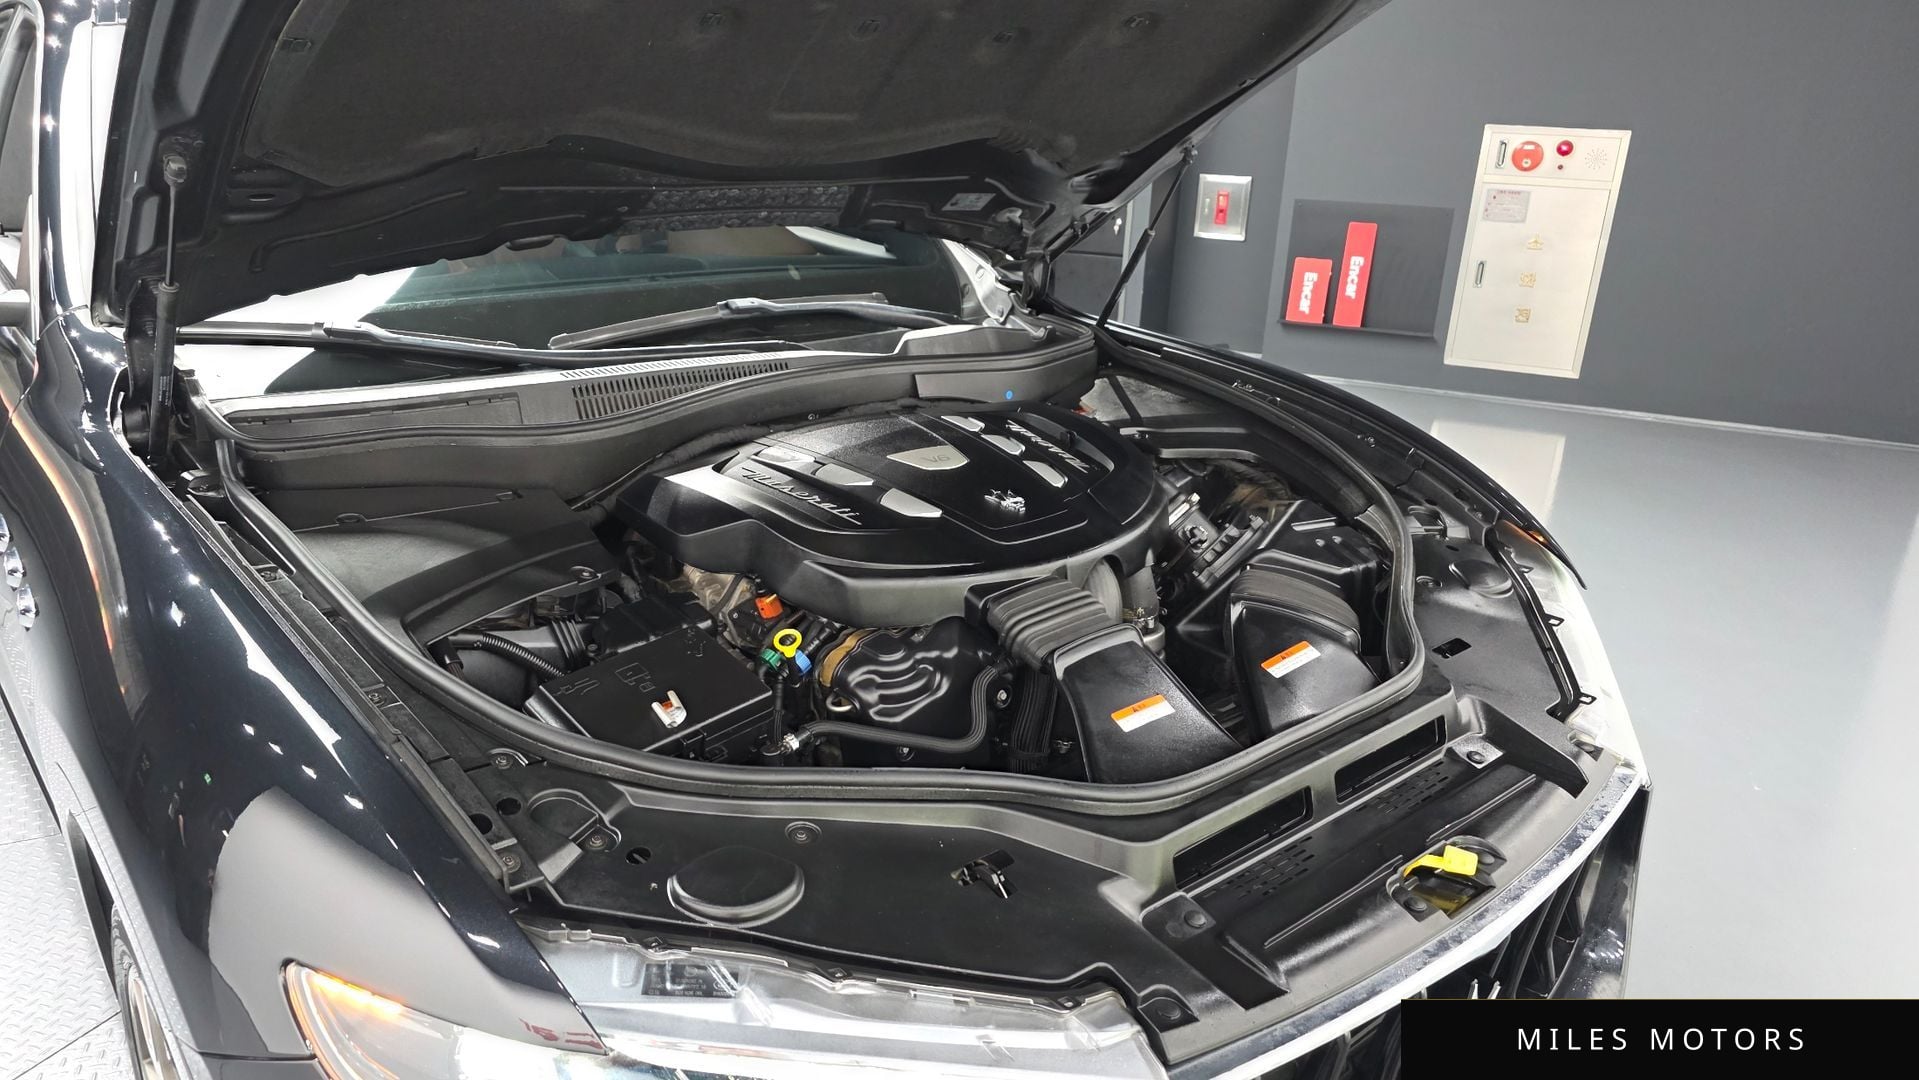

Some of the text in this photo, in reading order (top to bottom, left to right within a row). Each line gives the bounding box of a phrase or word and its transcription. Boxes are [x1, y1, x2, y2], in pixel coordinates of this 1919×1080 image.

[1299, 271, 1318, 315] Encar
[1345, 255, 1364, 300] Encar
[921, 454, 951, 463] V6
[741, 467, 862, 526] Maserati
